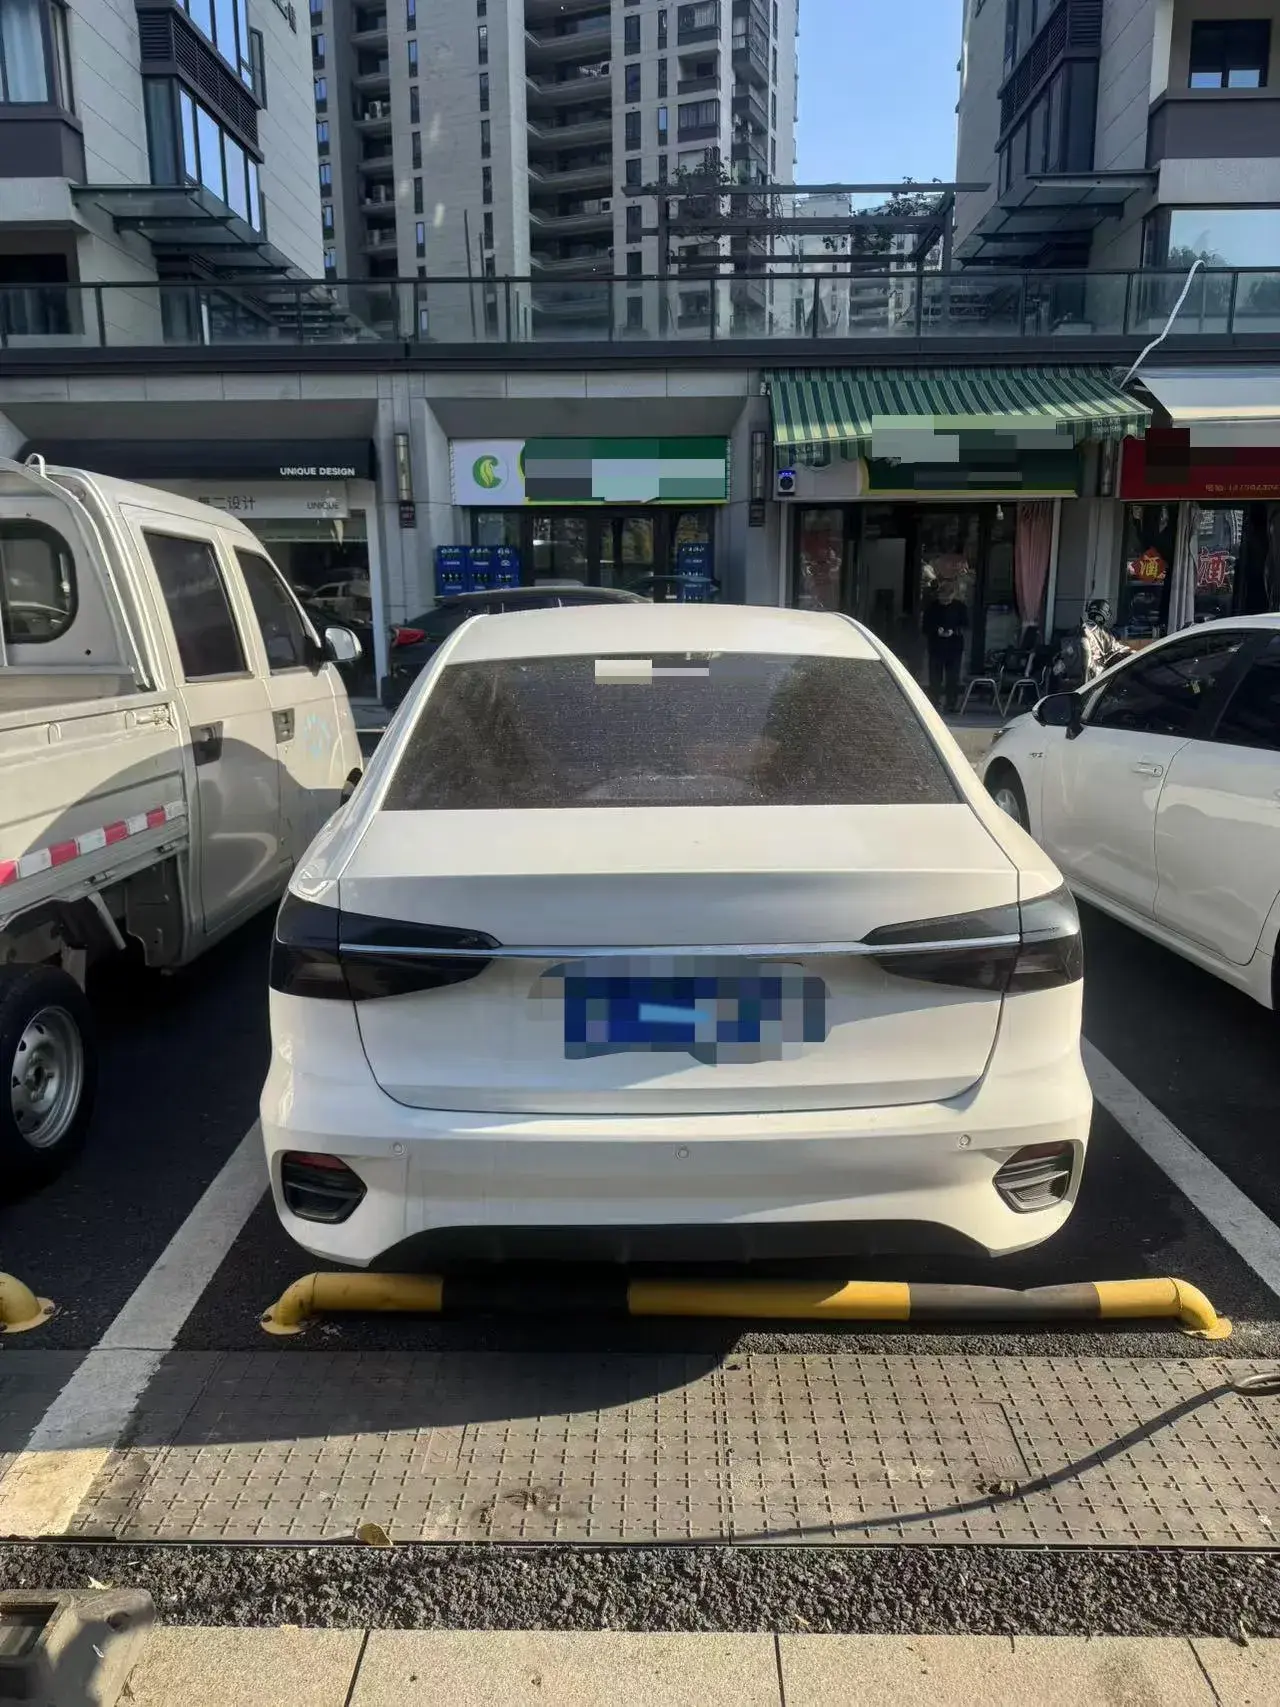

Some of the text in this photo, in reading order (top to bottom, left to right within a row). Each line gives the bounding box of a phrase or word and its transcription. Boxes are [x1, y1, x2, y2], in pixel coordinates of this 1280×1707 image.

[280, 467, 355, 476] UNIQUE DESIGN
[307, 501, 339, 510] UNIQUE
